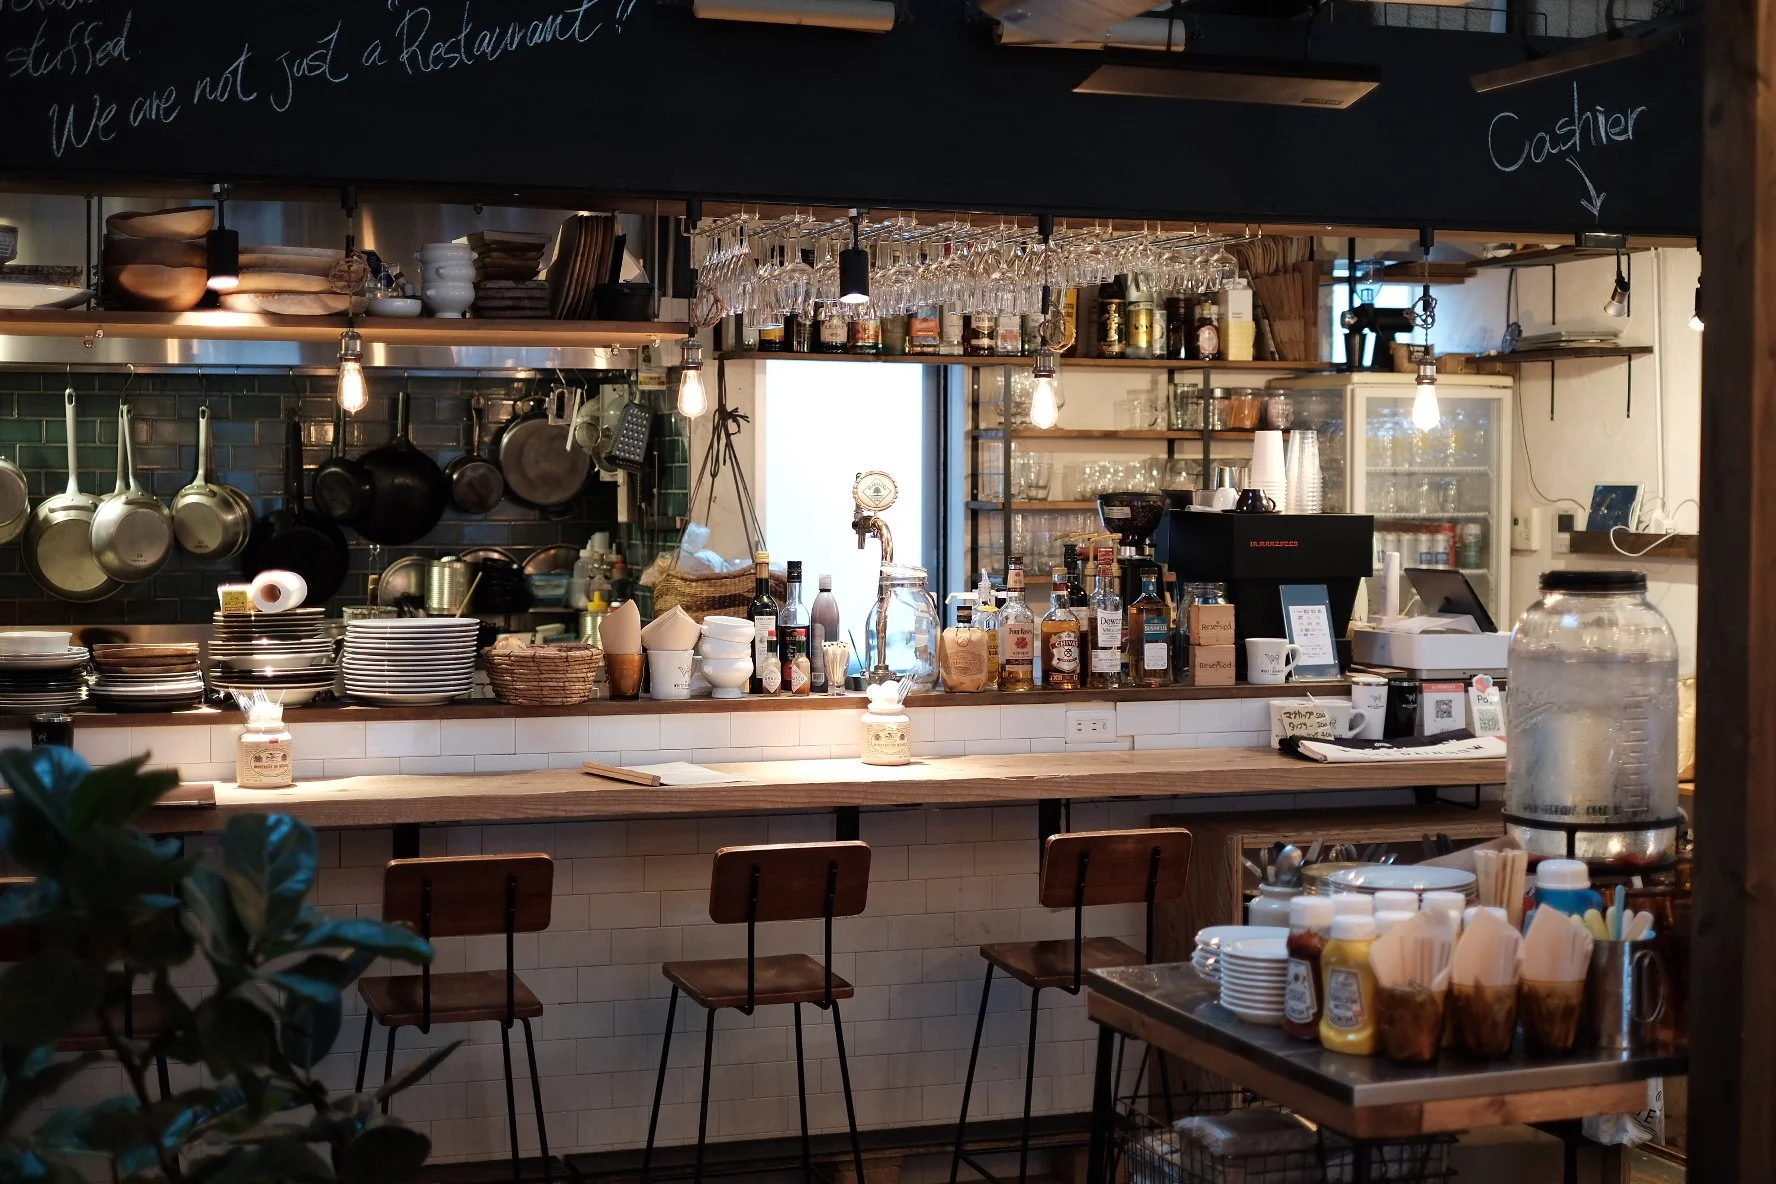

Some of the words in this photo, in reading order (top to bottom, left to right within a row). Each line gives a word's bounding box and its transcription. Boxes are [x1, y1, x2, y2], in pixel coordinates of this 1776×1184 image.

[50, 94, 117, 157] We
[130, 85, 181, 128] are
[194, 43, 257, 105] not
[270, 20, 349, 112] just
[362, 38, 389, 68] a
[1488, 80, 1647, 172] Cashier
[1201, 622, 1232, 631] Reserved
[1199, 661, 1232, 669] Reserved
